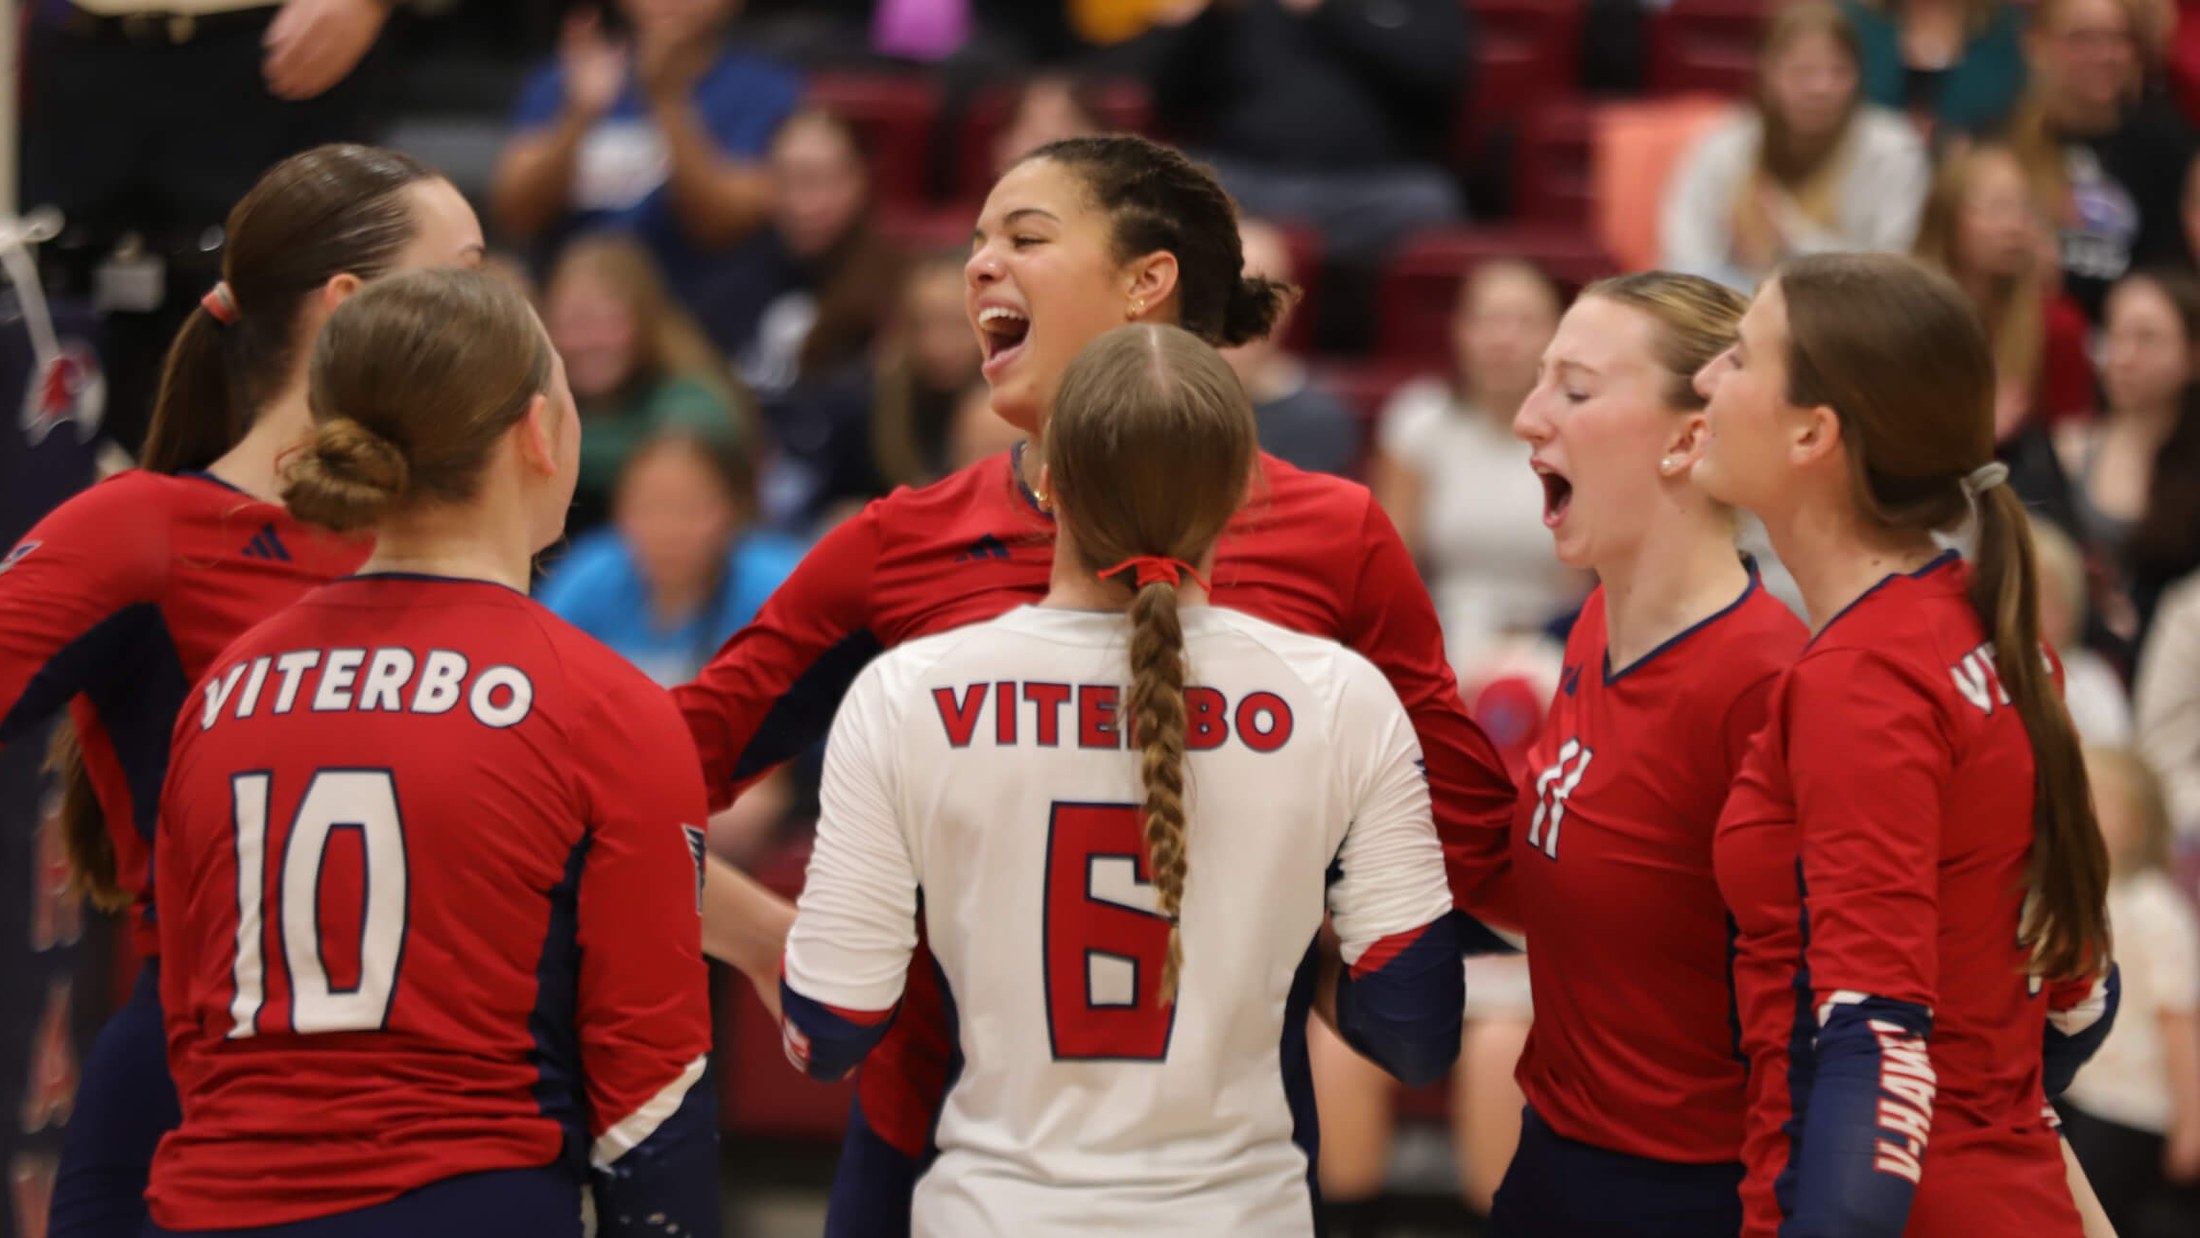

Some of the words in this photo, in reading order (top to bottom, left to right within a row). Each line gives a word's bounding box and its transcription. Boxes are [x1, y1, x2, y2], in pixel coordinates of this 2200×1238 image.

[201, 647, 534, 731] VITERBO
[931, 681, 1293, 753] VITEBO
[1527, 737, 1593, 862] 11
[224, 767, 409, 1039] 10
[1043, 801, 1181, 1062] 6
